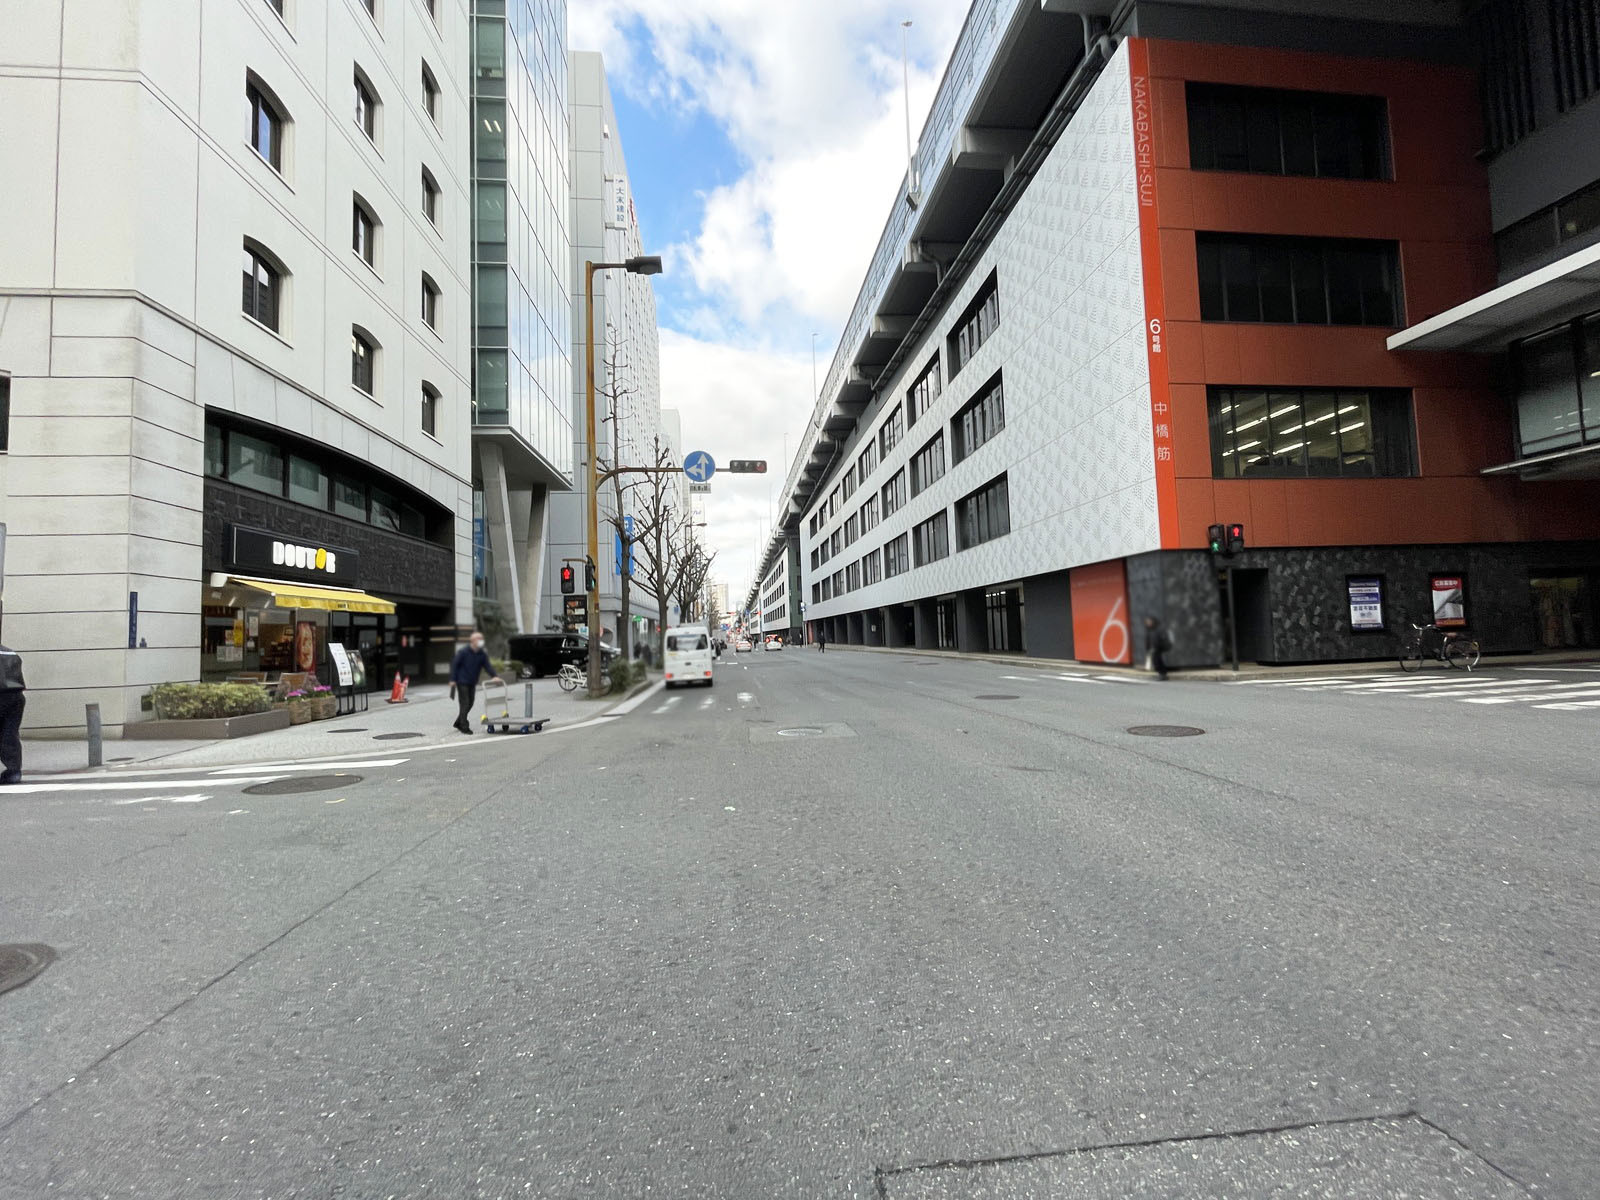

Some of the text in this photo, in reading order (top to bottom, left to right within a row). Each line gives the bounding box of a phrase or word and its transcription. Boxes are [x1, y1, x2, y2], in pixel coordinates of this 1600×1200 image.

[1134, 76, 1153, 206] NAKABASHI-SUJI
[1154, 402, 1171, 461] 中橋筋
[272, 541, 336, 574] DOUTOR
[1099, 597, 1128, 663] 6
